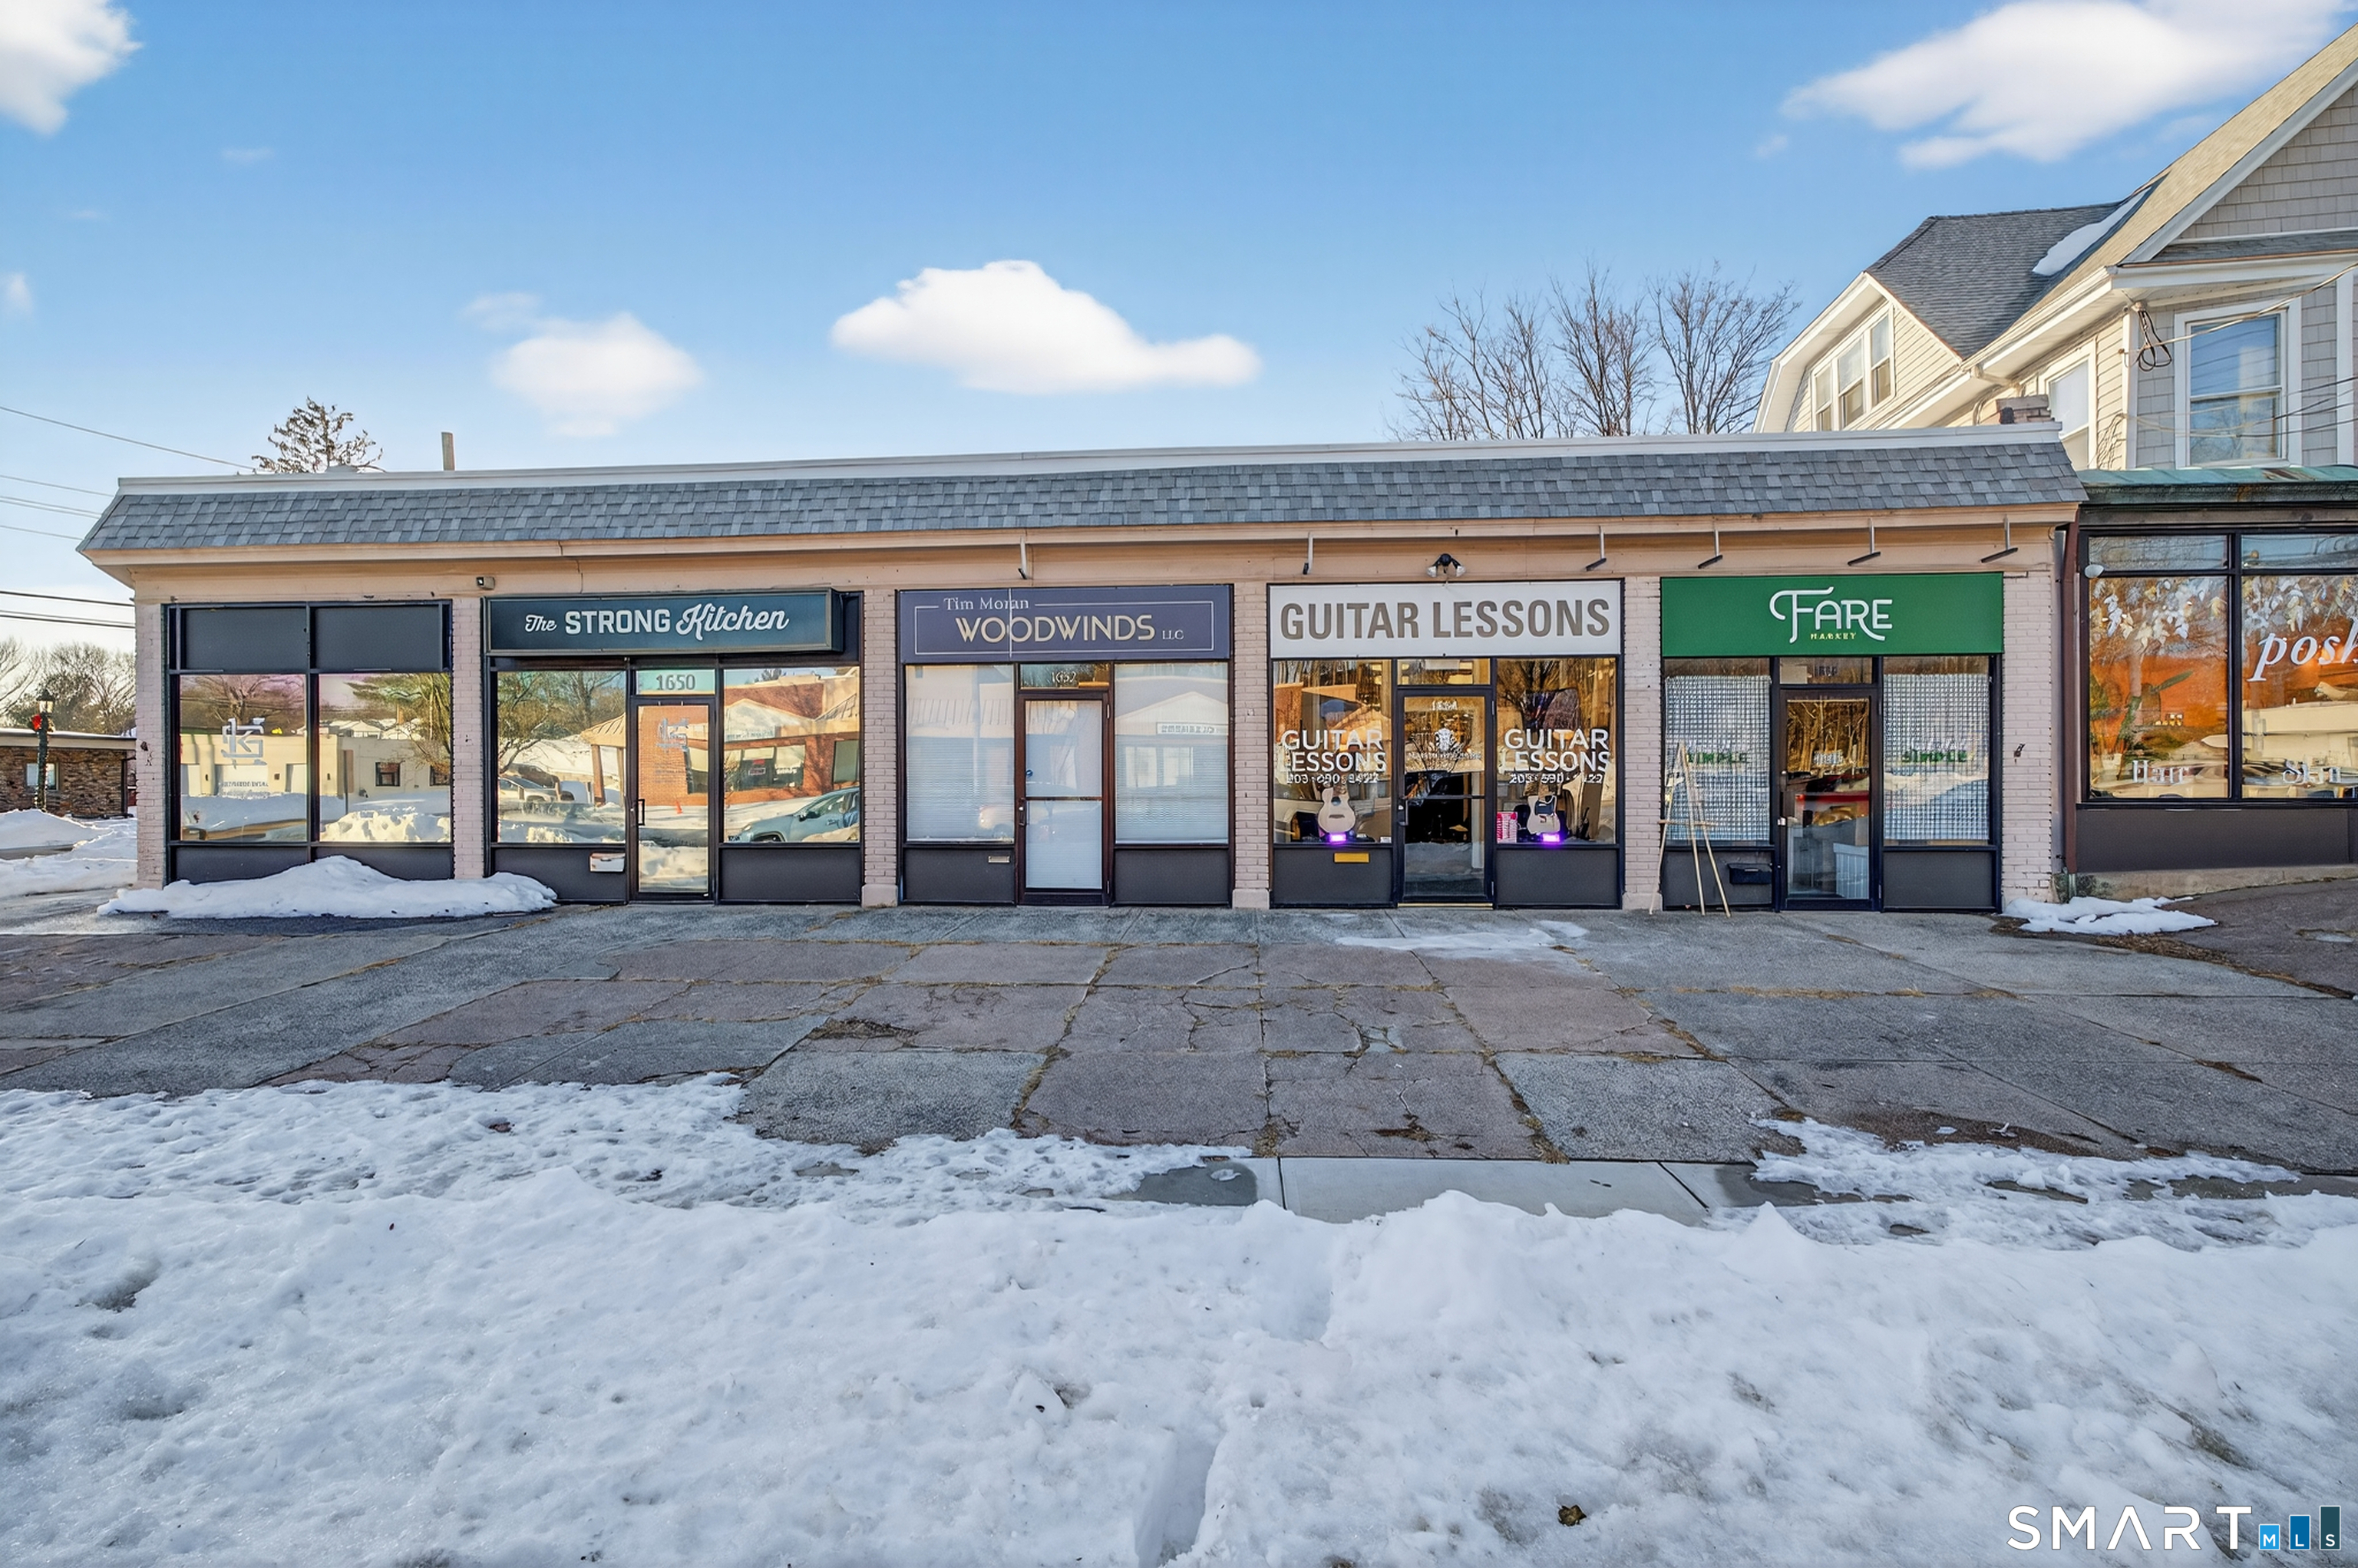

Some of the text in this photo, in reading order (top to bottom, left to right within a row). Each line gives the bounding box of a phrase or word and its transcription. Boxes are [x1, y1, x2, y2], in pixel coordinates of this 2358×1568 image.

[943, 597, 1029, 610] Tim Moran
[525, 603, 789, 641] The STRONG Kitchen
[1280, 599, 1610, 639] GUITAR LESSONS
[1769, 586, 1893, 644] FARE
[956, 615, 1184, 643] WOODWINDS LLC
[656, 674, 695, 690] 1650
[1280, 729, 1384, 750] GUITAR
[1504, 728, 1610, 750] GUITAR
[1280, 751, 1387, 772] LESSONS
[1503, 751, 1611, 772] LESSONS
